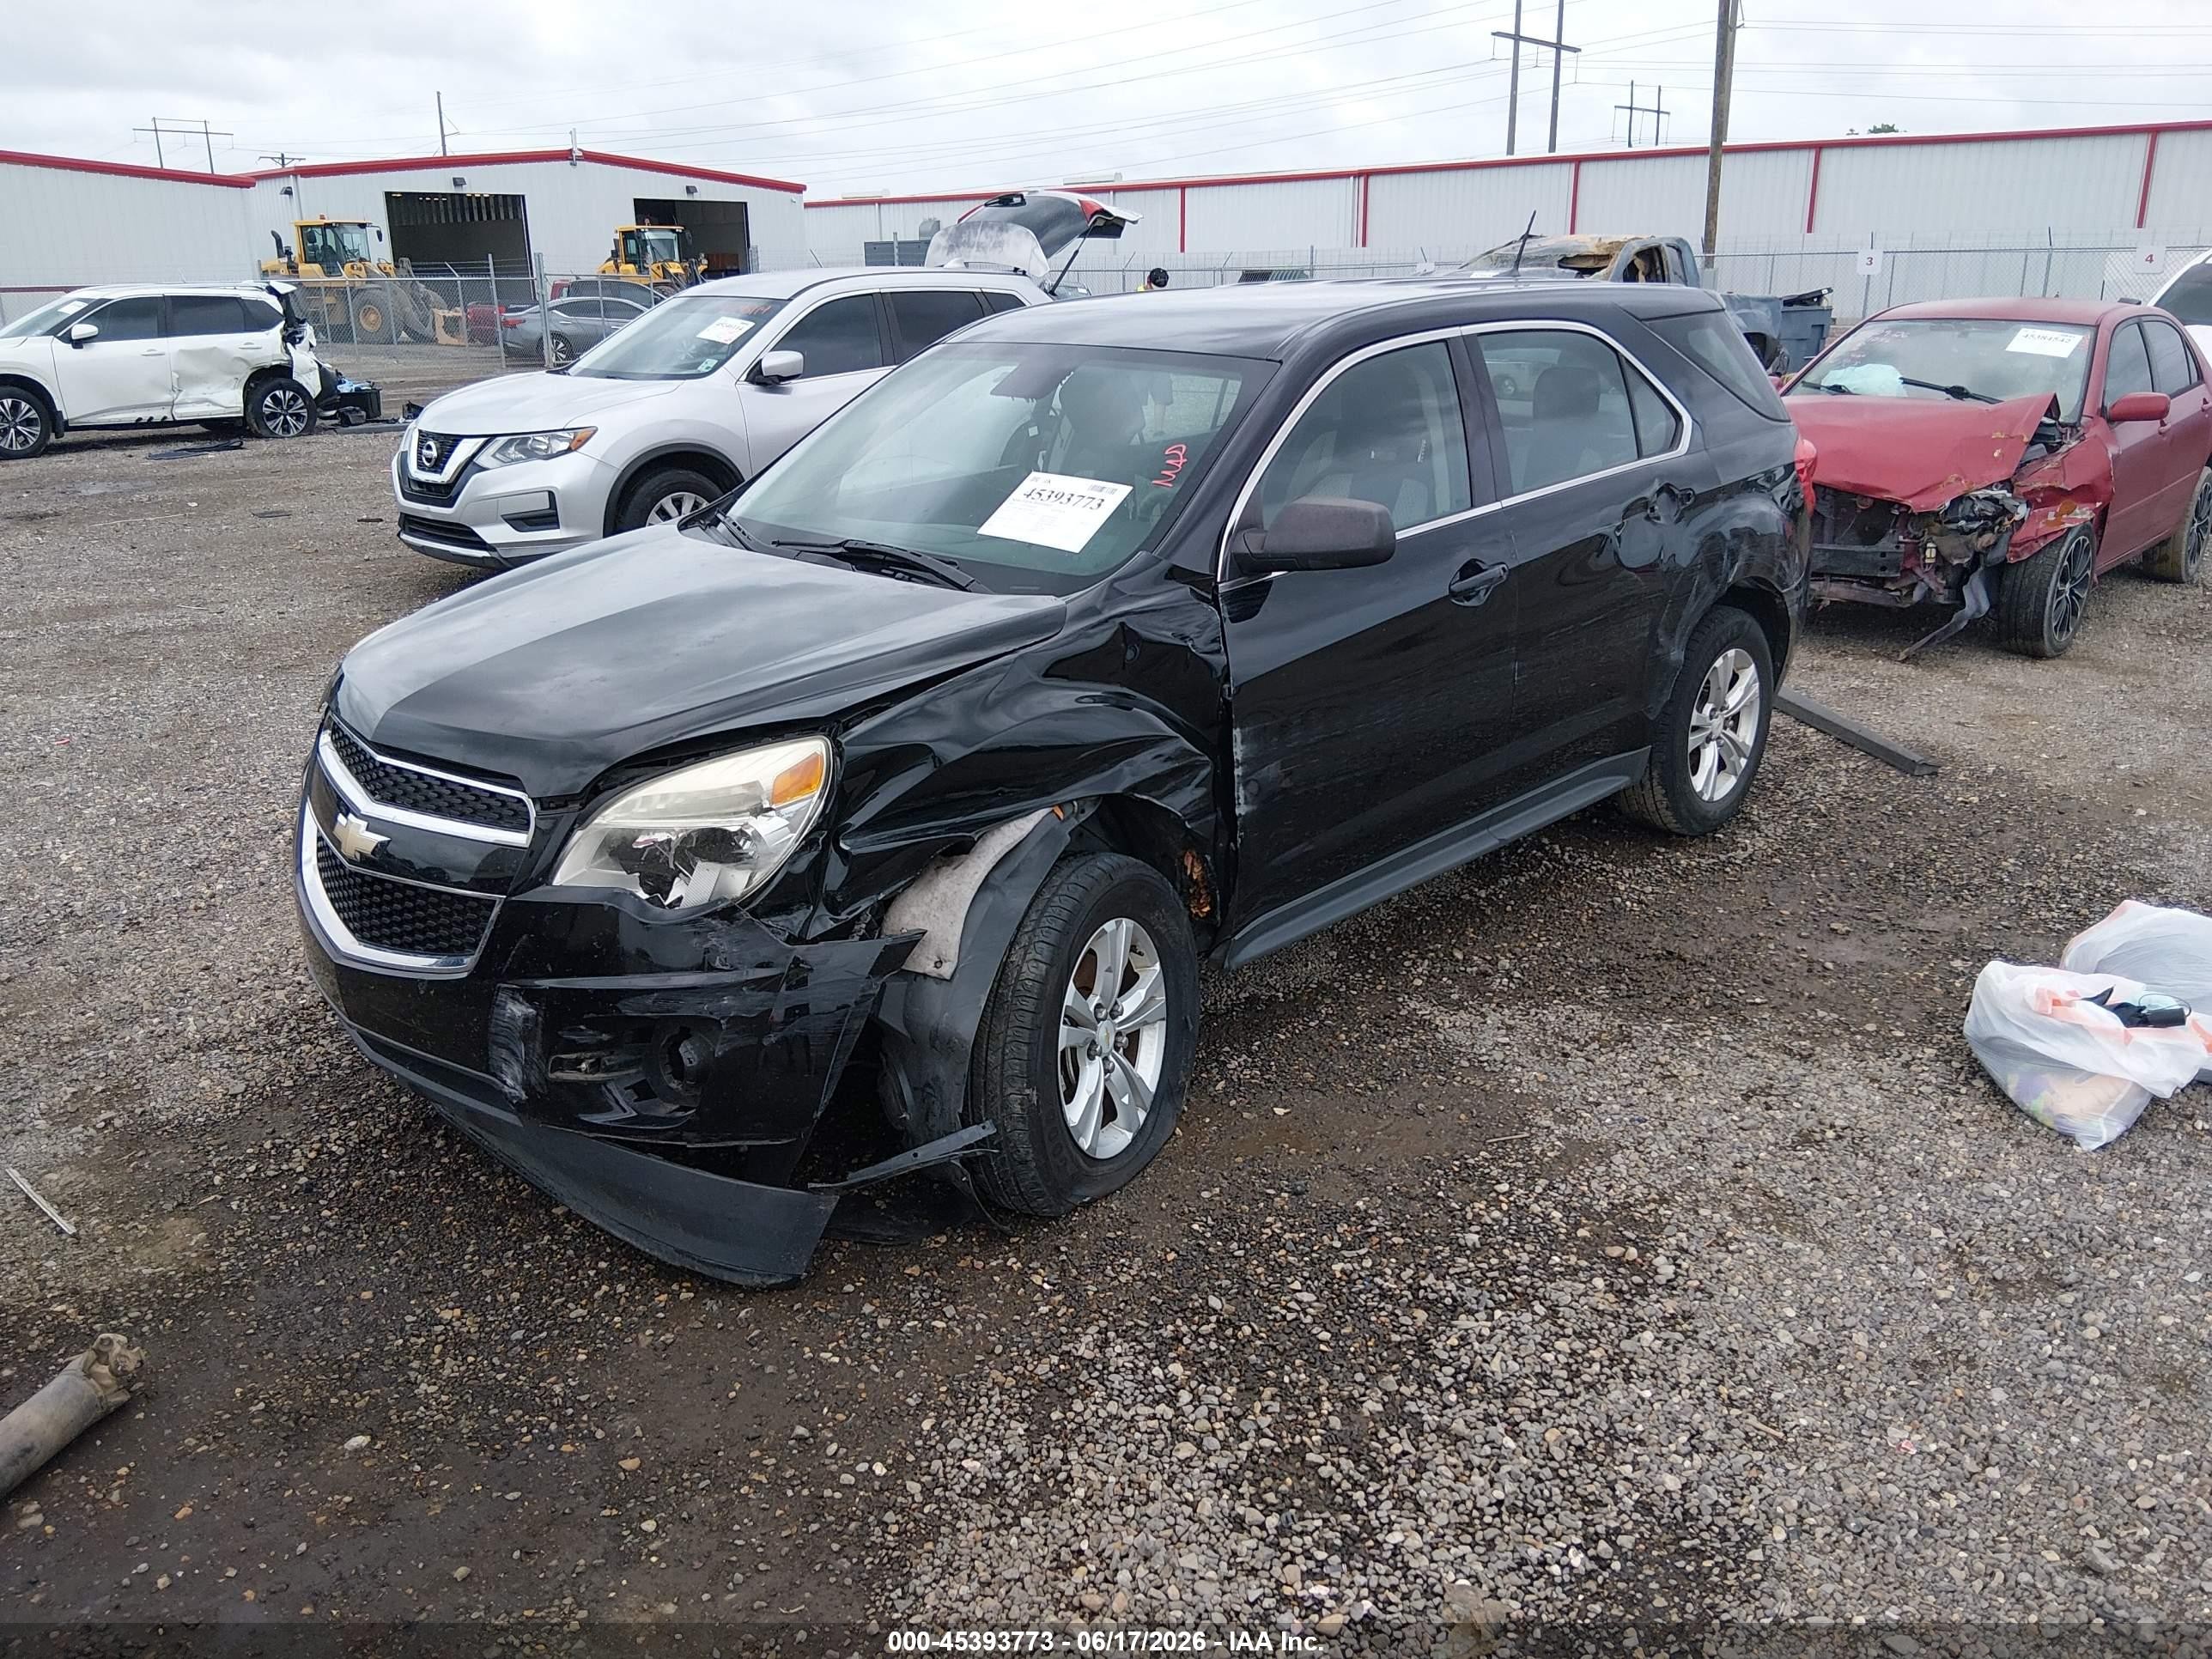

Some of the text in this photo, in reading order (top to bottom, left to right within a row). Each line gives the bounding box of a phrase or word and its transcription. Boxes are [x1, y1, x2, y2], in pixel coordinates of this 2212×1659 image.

[1865, 256, 1874, 266] 3
[2145, 253, 2154, 264] 4
[1023, 486, 1105, 511] 45393773
